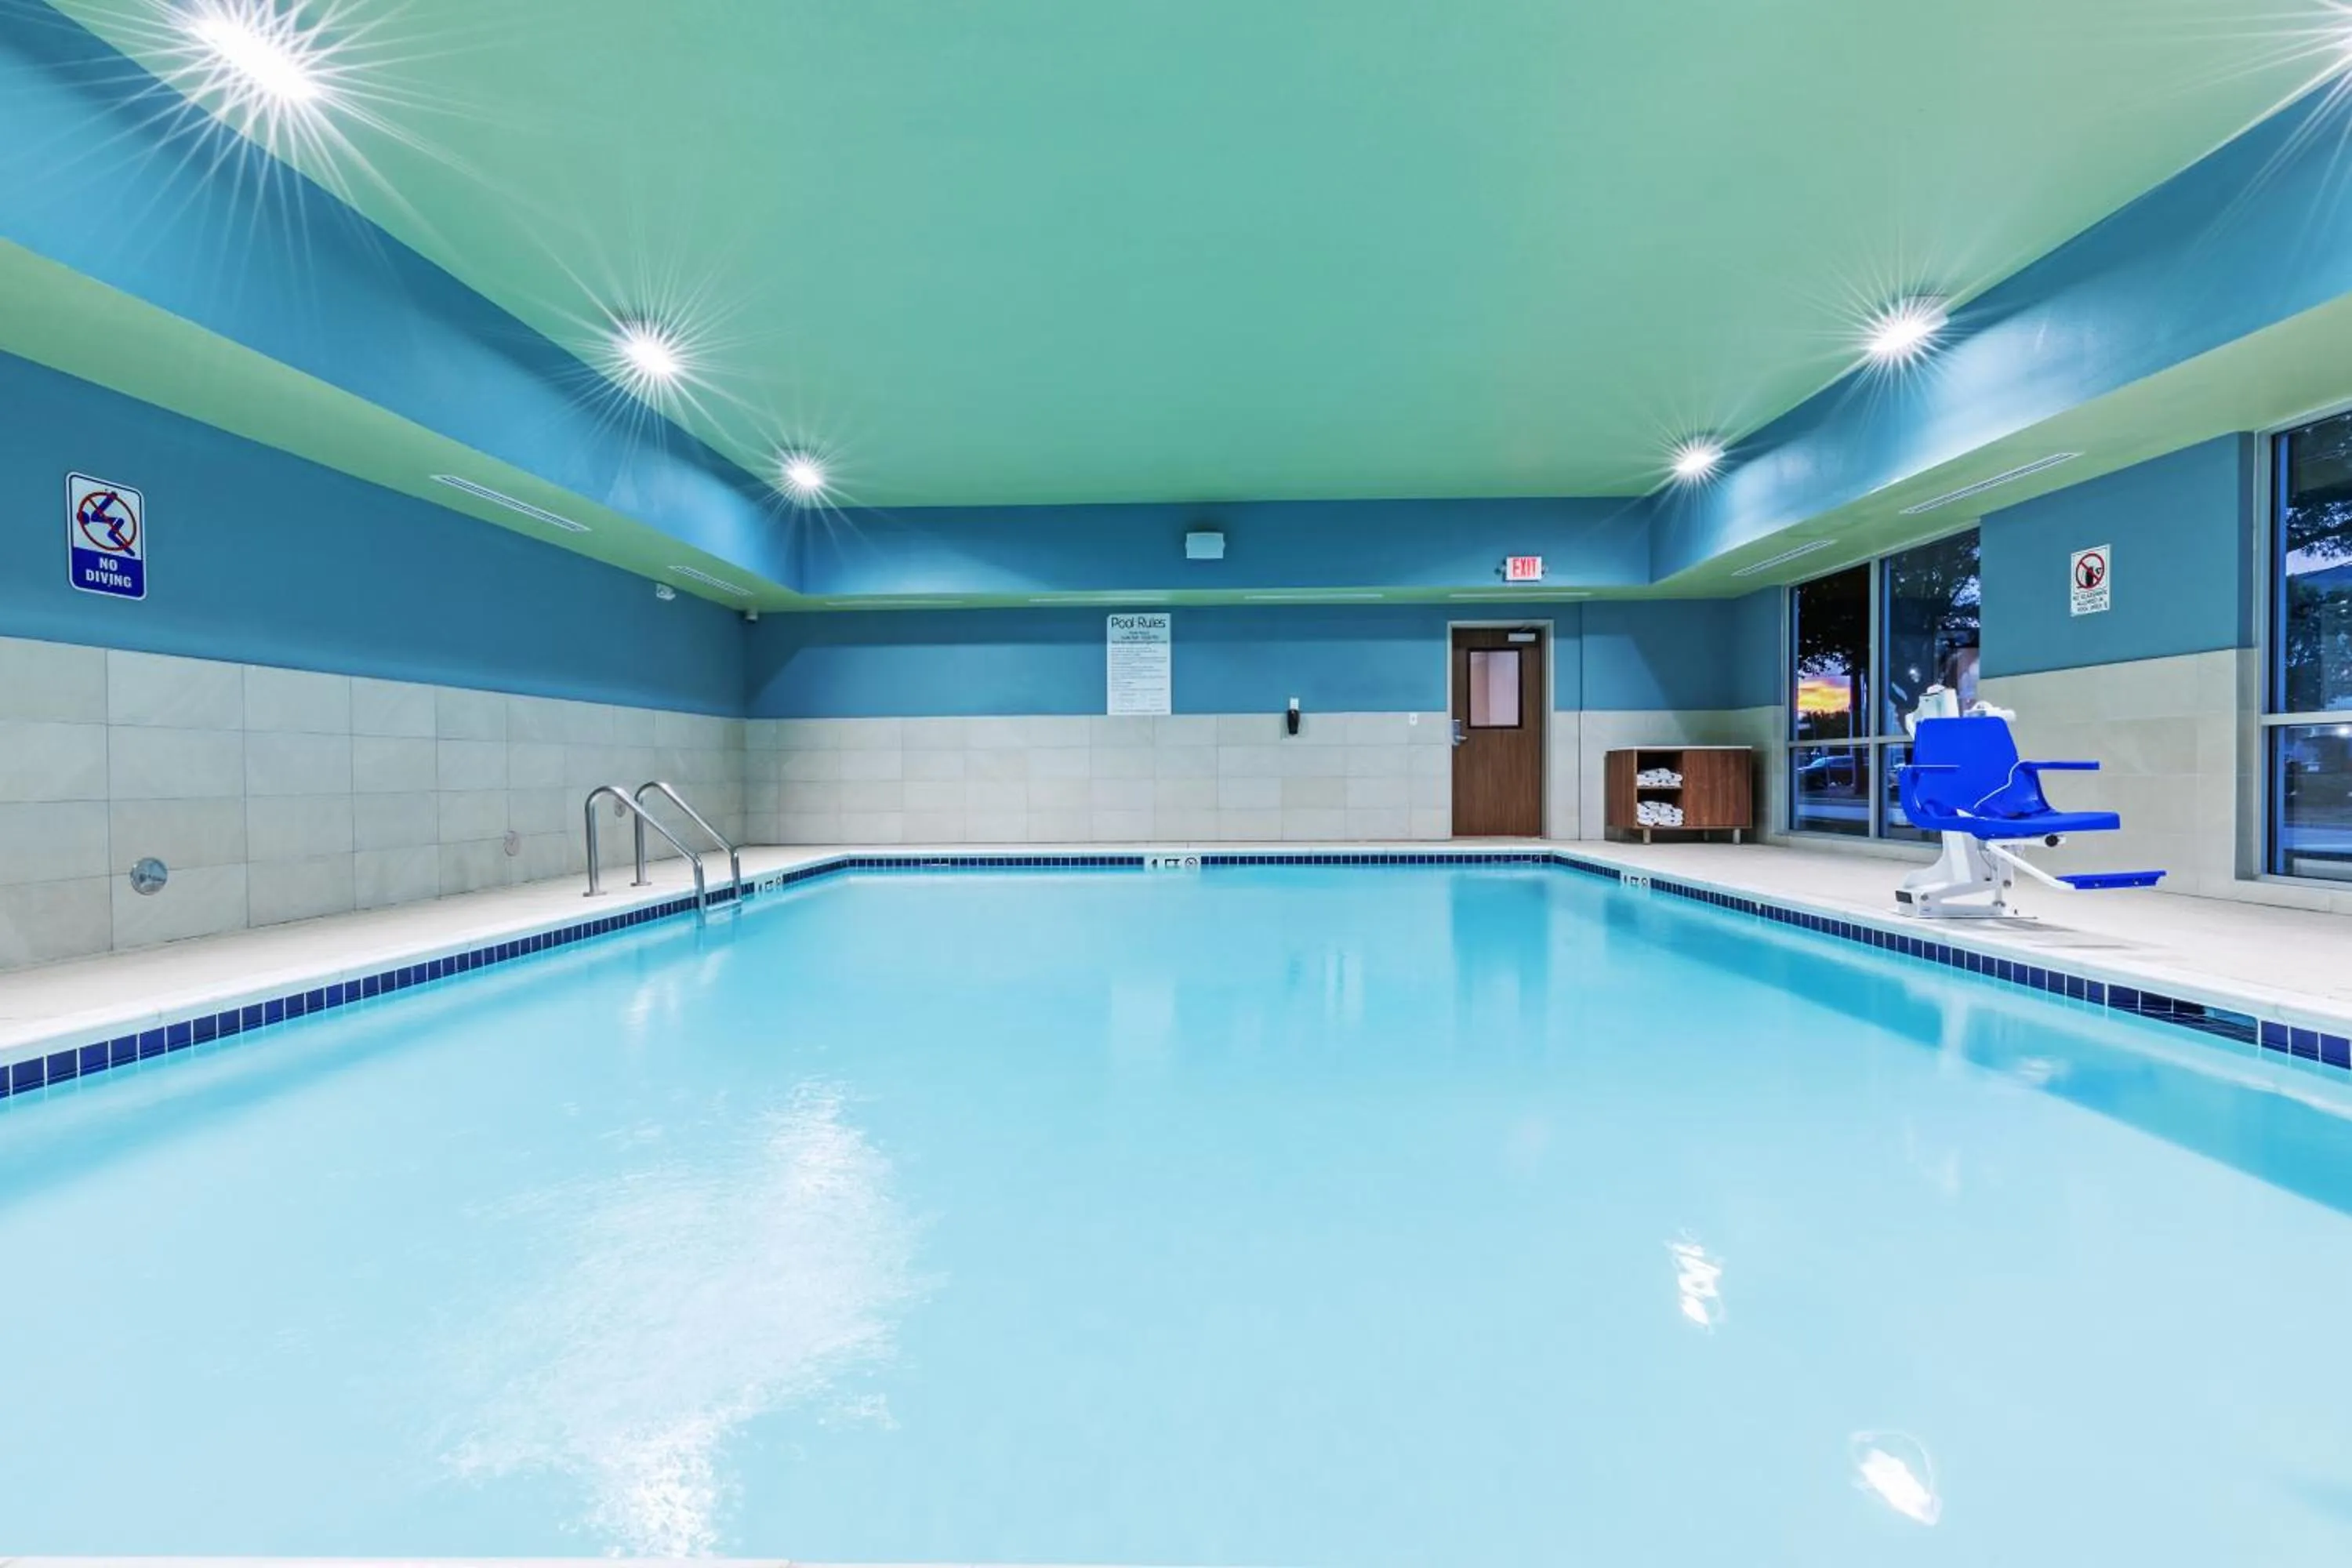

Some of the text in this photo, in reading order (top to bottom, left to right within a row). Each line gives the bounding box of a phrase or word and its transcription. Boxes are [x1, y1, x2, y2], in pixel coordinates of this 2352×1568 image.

[99, 557, 118, 572] NO
[1512, 557, 1537, 578] EXIT
[85, 568, 132, 588] DIVING
[1111, 615, 1166, 630] Pool Rules
